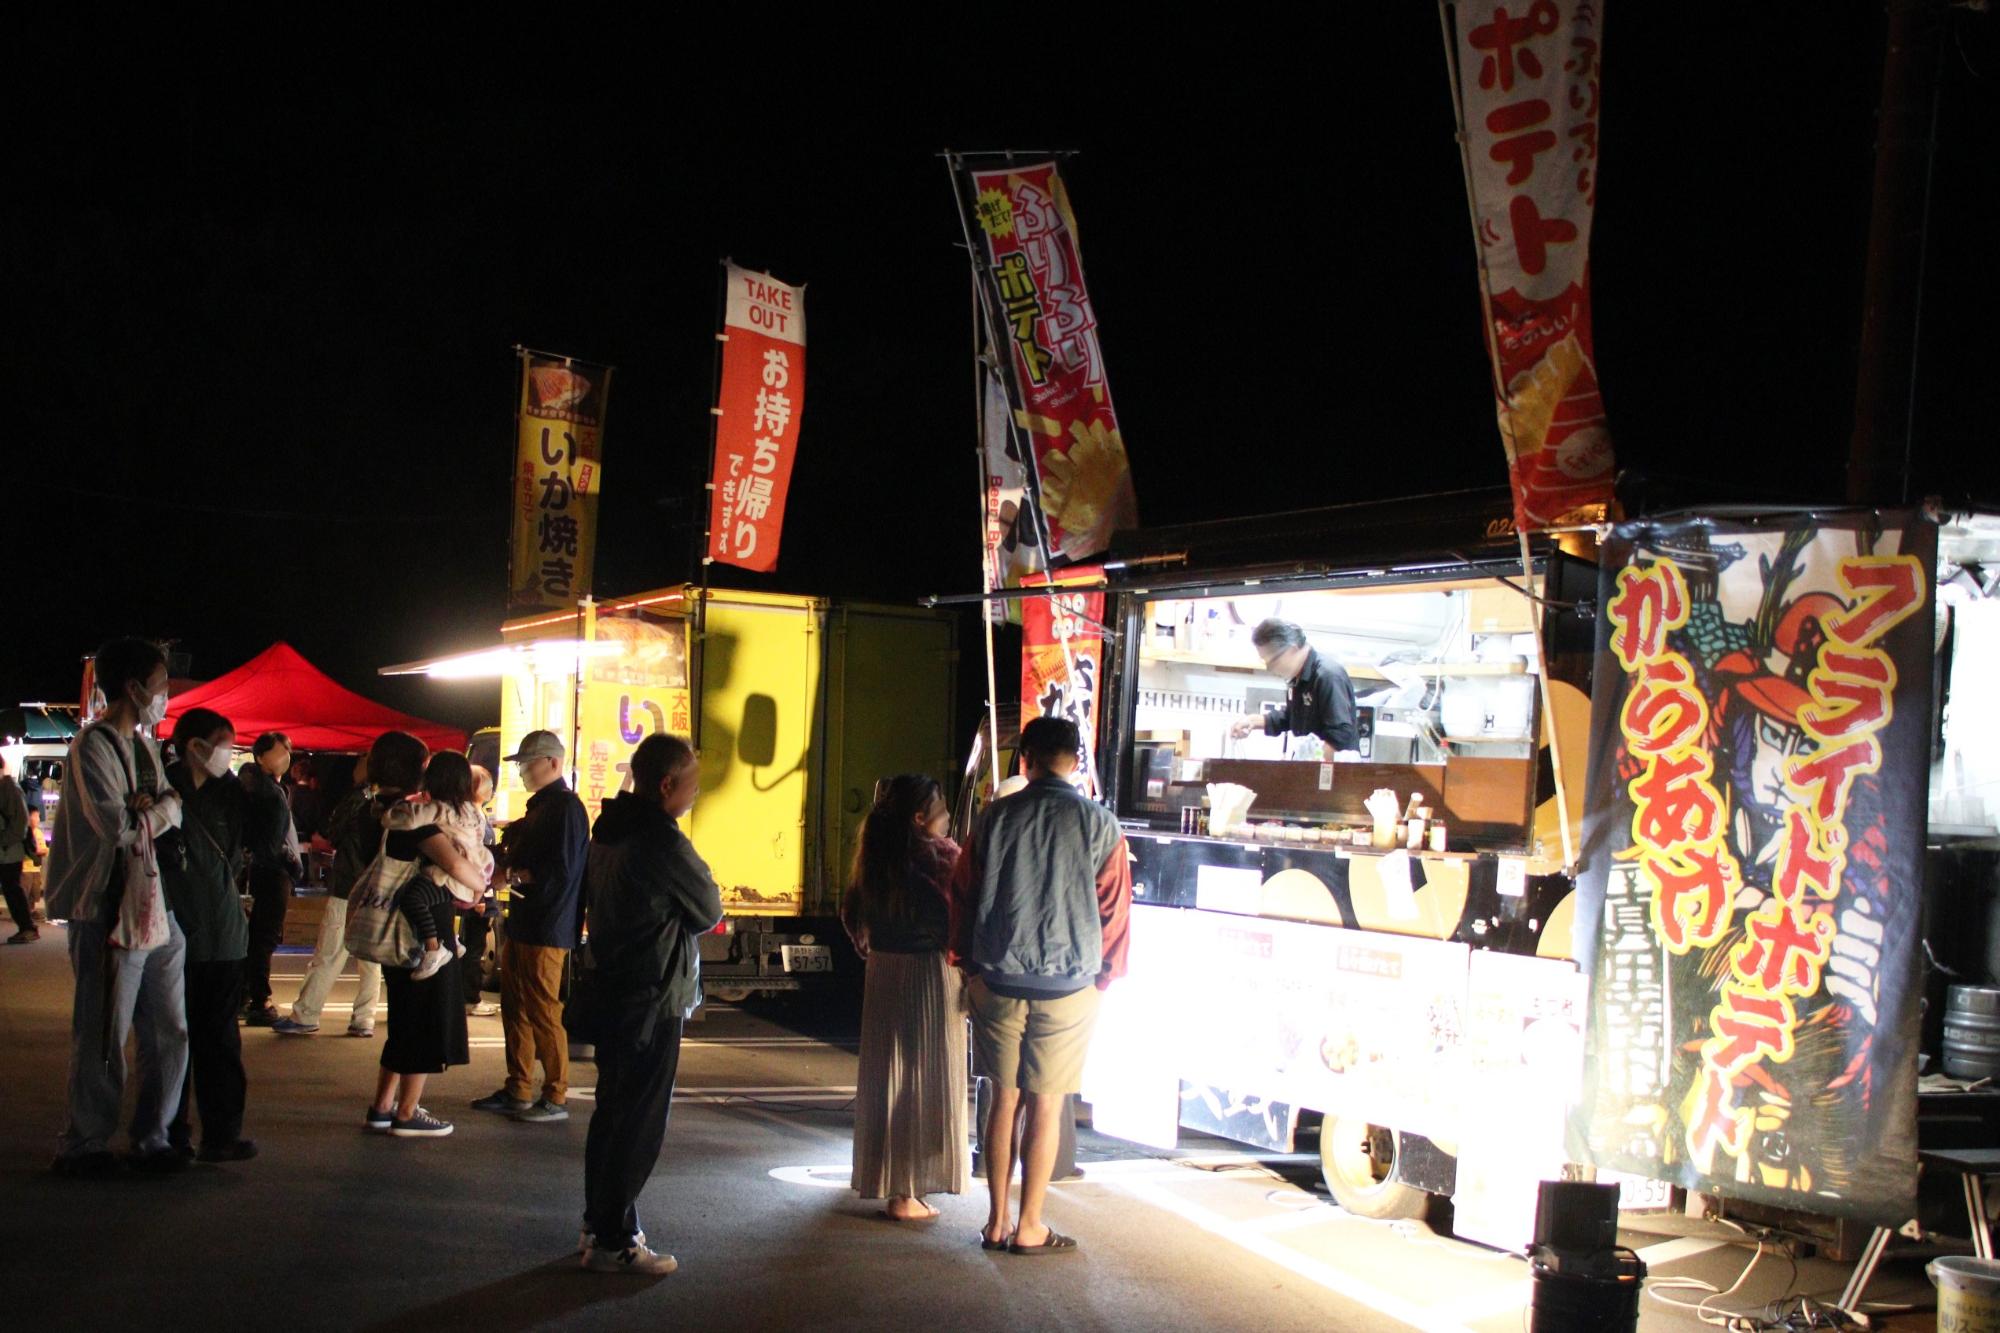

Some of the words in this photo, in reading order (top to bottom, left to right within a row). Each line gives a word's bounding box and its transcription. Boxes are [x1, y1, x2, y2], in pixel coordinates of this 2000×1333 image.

[1468, 0, 1577, 275] ポテト
[744, 277, 792, 311] TAKE
[748, 304, 788, 333] OUT
[996, 254, 1053, 385] ポテト
[538, 427, 578, 598] いか焼き
[718, 453, 744, 555] できます
[735, 349, 791, 560] お持ち帰り
[671, 691, 689, 732] 大阪
[1609, 558, 1734, 953] からあげ
[1688, 556, 1923, 1164] フライドポテト
